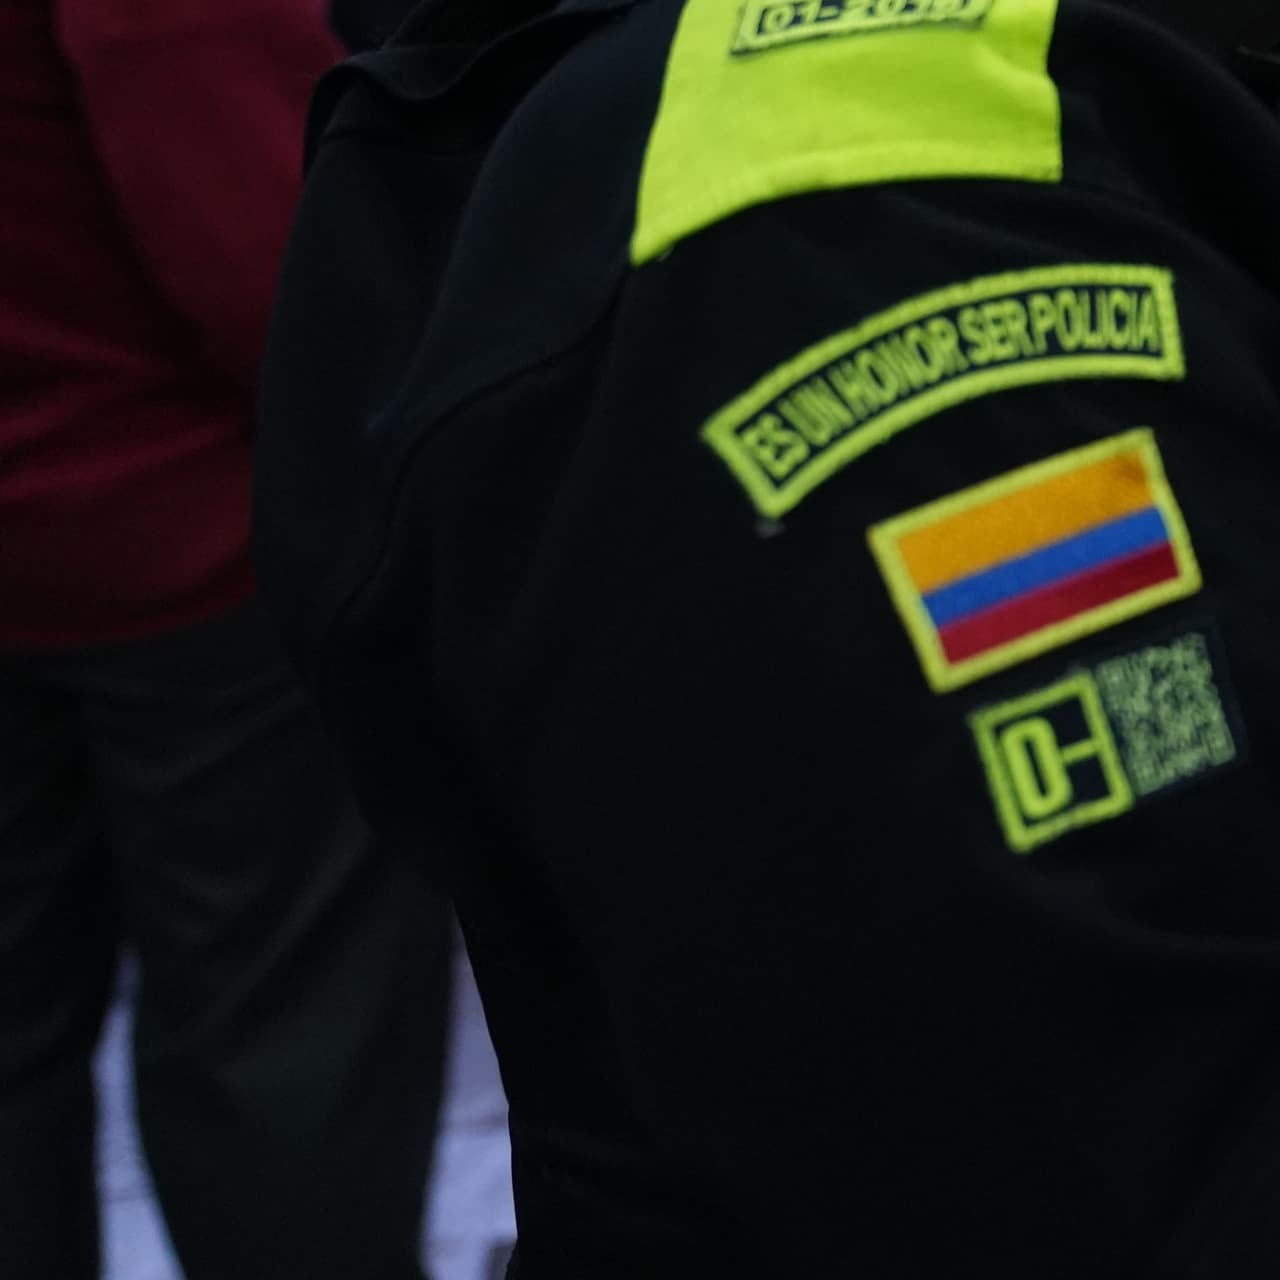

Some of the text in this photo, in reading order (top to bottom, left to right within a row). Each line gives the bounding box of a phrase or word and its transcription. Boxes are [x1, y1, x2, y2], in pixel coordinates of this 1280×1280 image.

[741, 287, 1161, 480] ES UN HONOR SER POLICIA
